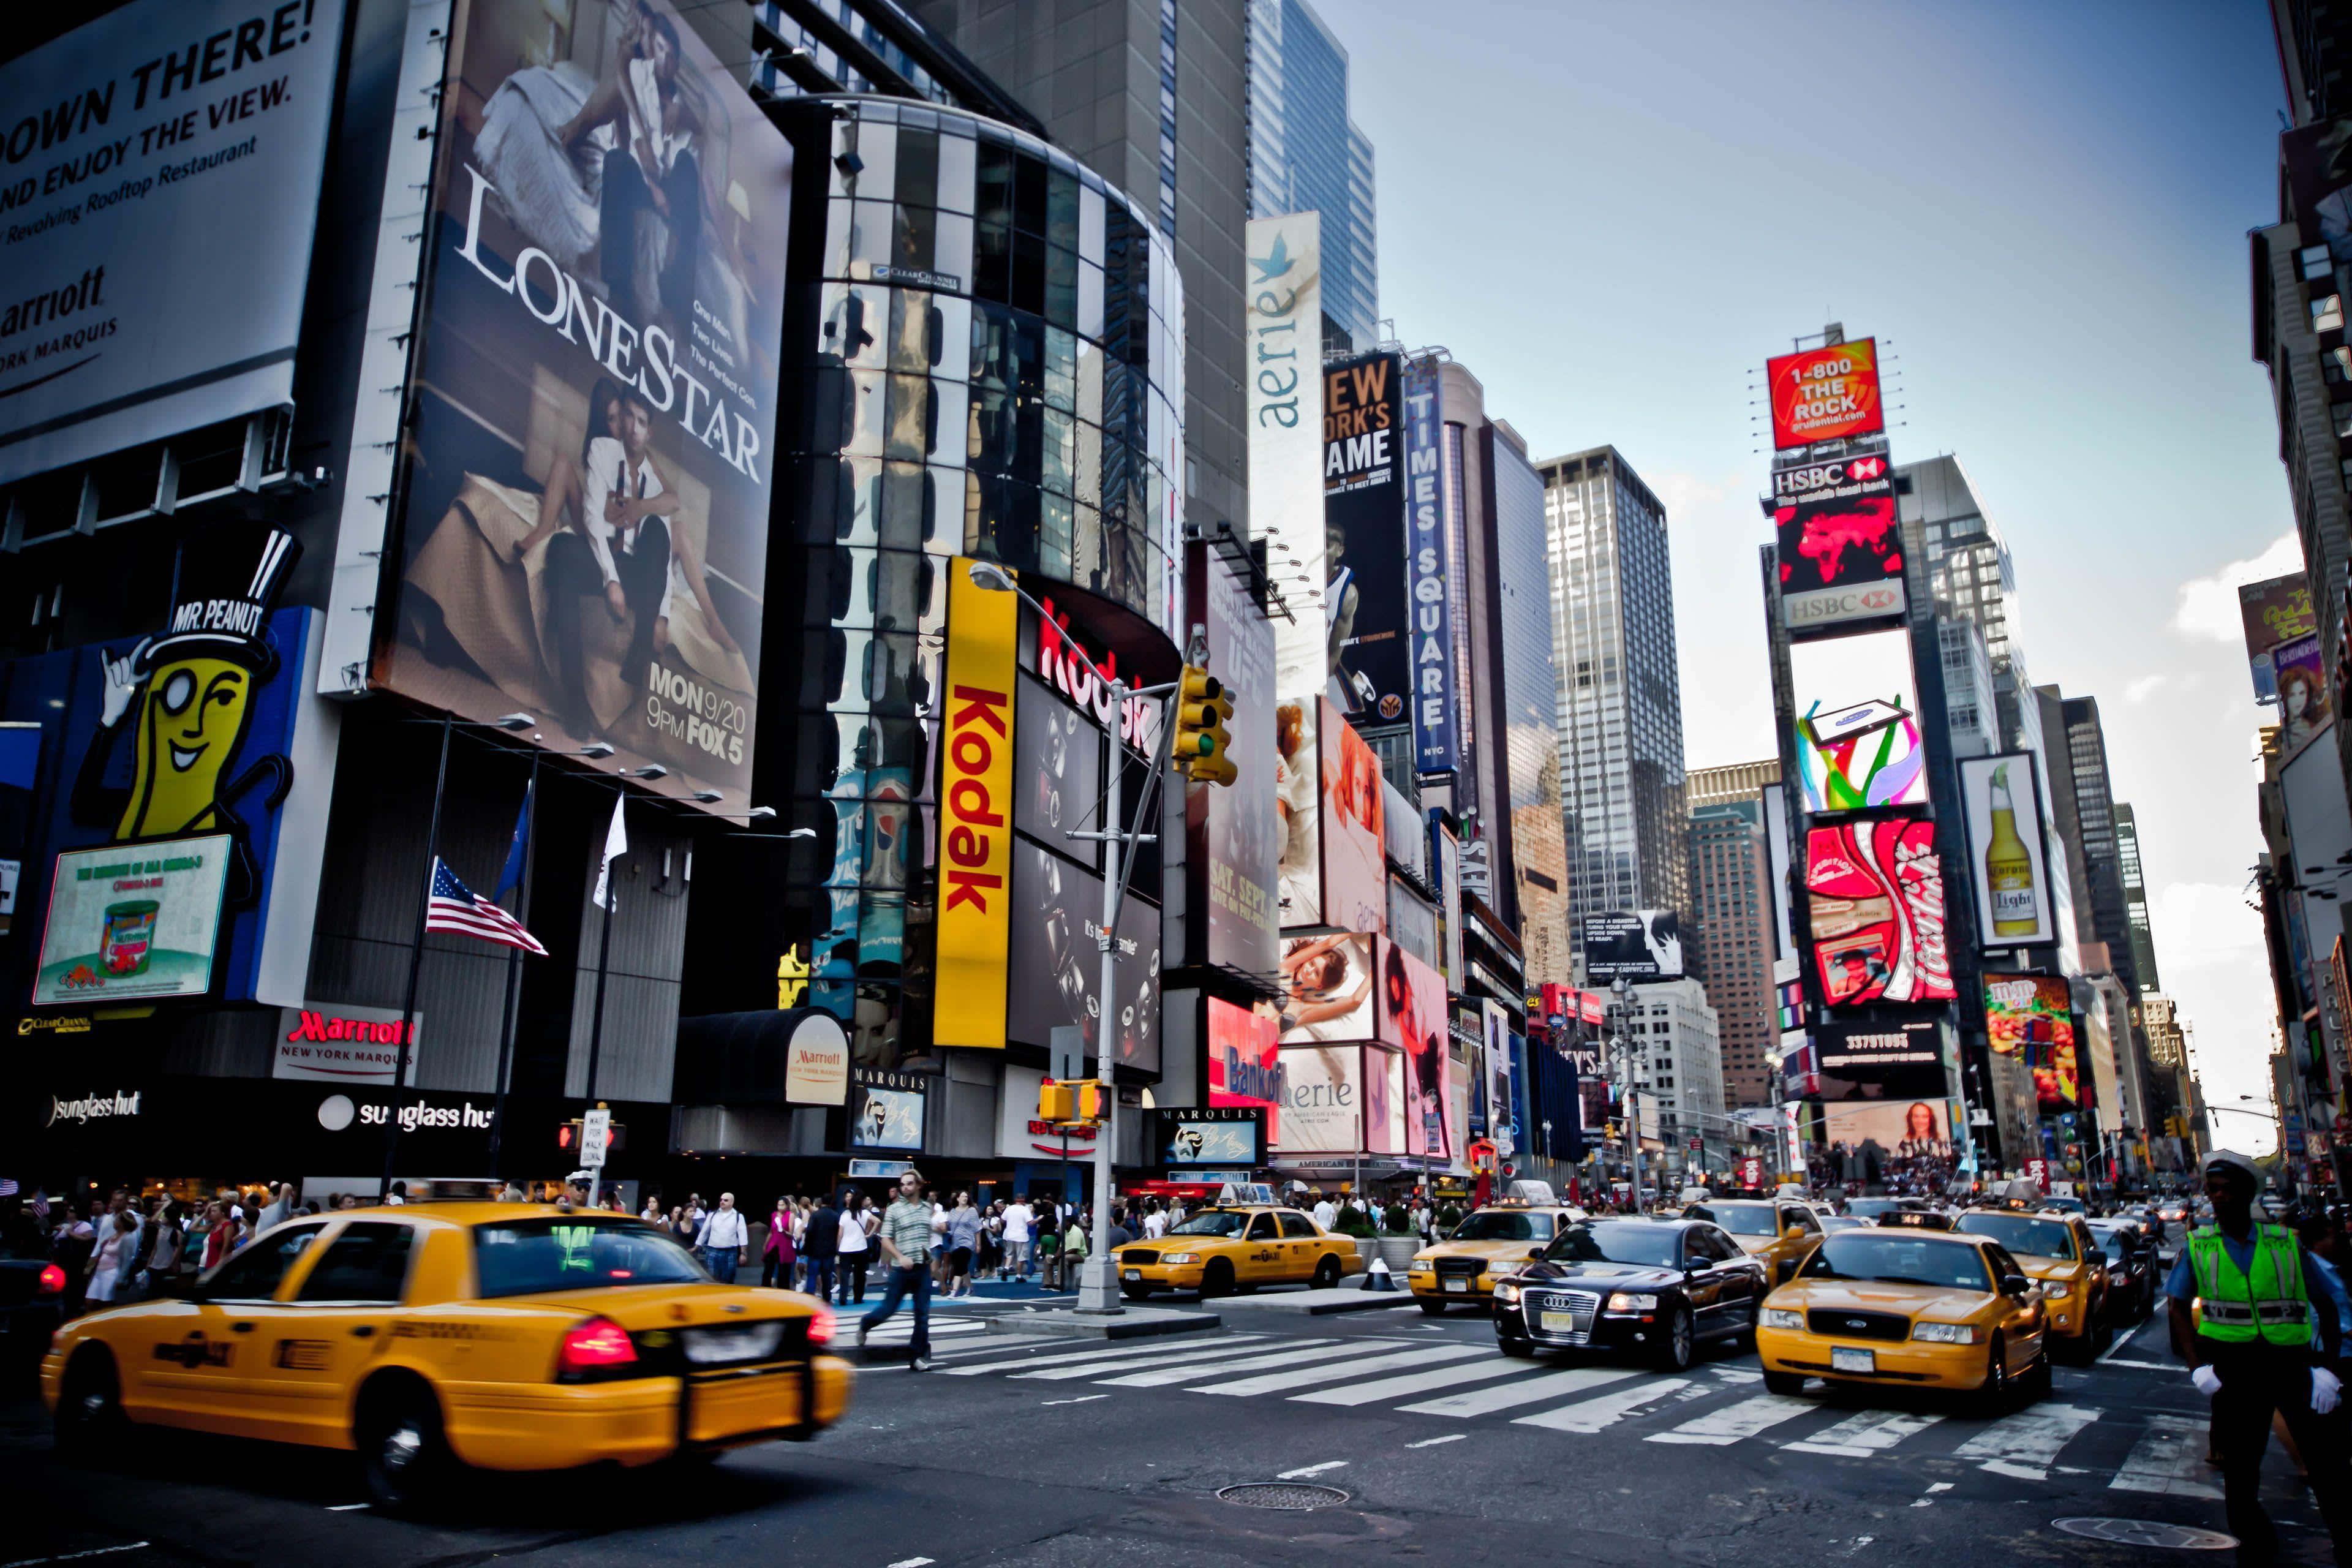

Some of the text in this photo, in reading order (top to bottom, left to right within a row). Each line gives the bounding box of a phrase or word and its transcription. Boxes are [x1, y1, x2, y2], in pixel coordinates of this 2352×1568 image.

[0, 0, 315, 164] OWN THERE!
[43, 136, 132, 196] ENJOY
[140, 111, 197, 156] THE
[208, 76, 292, 130] VIEW.
[7, 205, 82, 244] Revolving
[86, 177, 153, 213] Rooftop
[159, 136, 256, 186] Restaurant
[693, 300, 710, 323] One
[35, 317, 117, 361] MARQUIS
[692, 321, 710, 345] Two
[691, 344, 706, 367] The
[1256, 288, 1298, 428] aerie
[1791, 358, 1852, 384] 1-800
[1323, 360, 1389, 415] EW
[1801, 377, 1845, 401] THE
[1791, 411, 1866, 433] prudential.com
[1794, 394, 1856, 421] ROCK
[1776, 464, 1843, 494] HSBC
[1409, 392, 1444, 726] TIMES SQUARE
[172, 599, 263, 636] MR. PEANUT
[1792, 594, 1858, 620] HSBC
[649, 662, 745, 734] MON 9/20
[687, 714, 728, 760] FOX
[728, 735, 744, 765] 5
[1424, 746, 1444, 756] NYC
[946, 684, 1008, 915] Kodak
[281, 1046, 311, 1058] NEW
[316, 1049, 350, 1061] YORK
[795, 1049, 840, 1066] Marriott
[854, 1068, 925, 1090] MARQUIS
[1224, 1044, 1267, 1098] Bank
[56, 1089, 142, 1125] sunglass hut
[1163, 1109, 1256, 1120] MARQUIS
